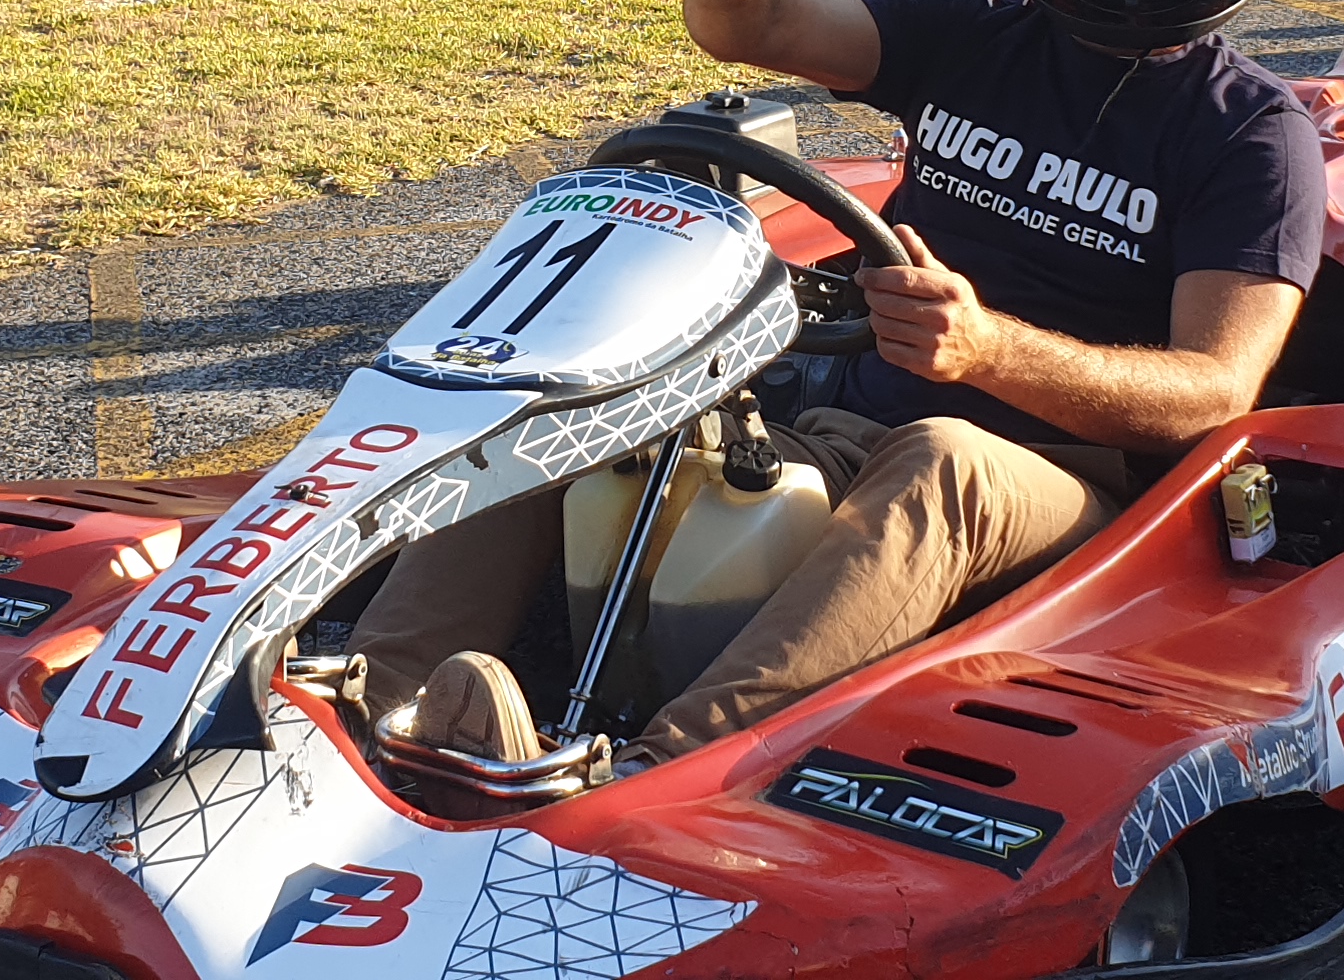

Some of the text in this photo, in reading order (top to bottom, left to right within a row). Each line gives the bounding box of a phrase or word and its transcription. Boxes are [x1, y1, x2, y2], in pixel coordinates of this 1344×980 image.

[916, 103, 1158, 234] HUGO PAULO
[522, 194, 707, 229] EUROINDY
[658, 225, 694, 242] Batalha
[1063, 222, 1146, 264] GERAL
[451, 219, 617, 335] 11
[444, 336, 505, 357] 24
[80, 422, 419, 730] FERBERTO
[789, 765, 1042, 855] PALOCAR
